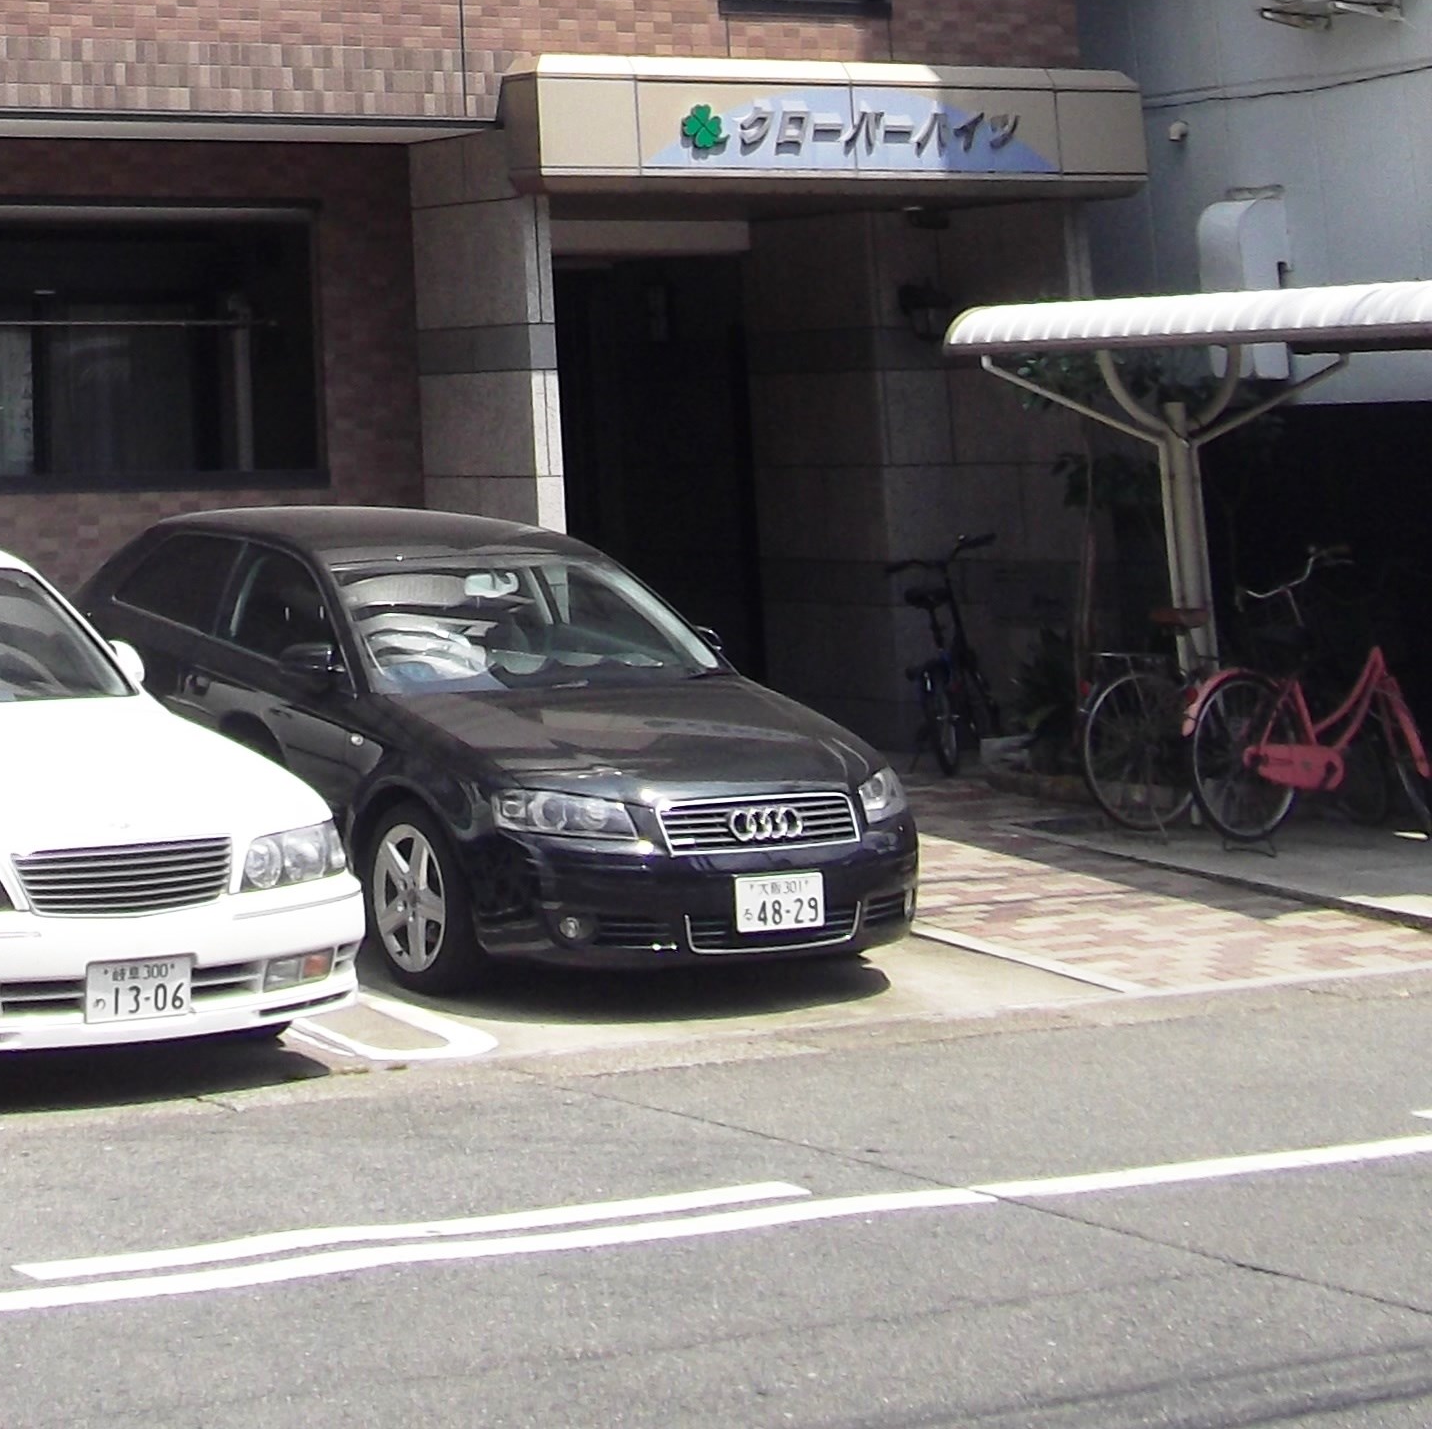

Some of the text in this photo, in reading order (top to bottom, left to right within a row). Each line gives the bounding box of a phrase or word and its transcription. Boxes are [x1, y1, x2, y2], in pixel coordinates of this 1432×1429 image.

[733, 99, 1021, 155] クローバーハイツ
[757, 897, 818, 926] 48-29
[114, 982, 184, 1016] 13-06
